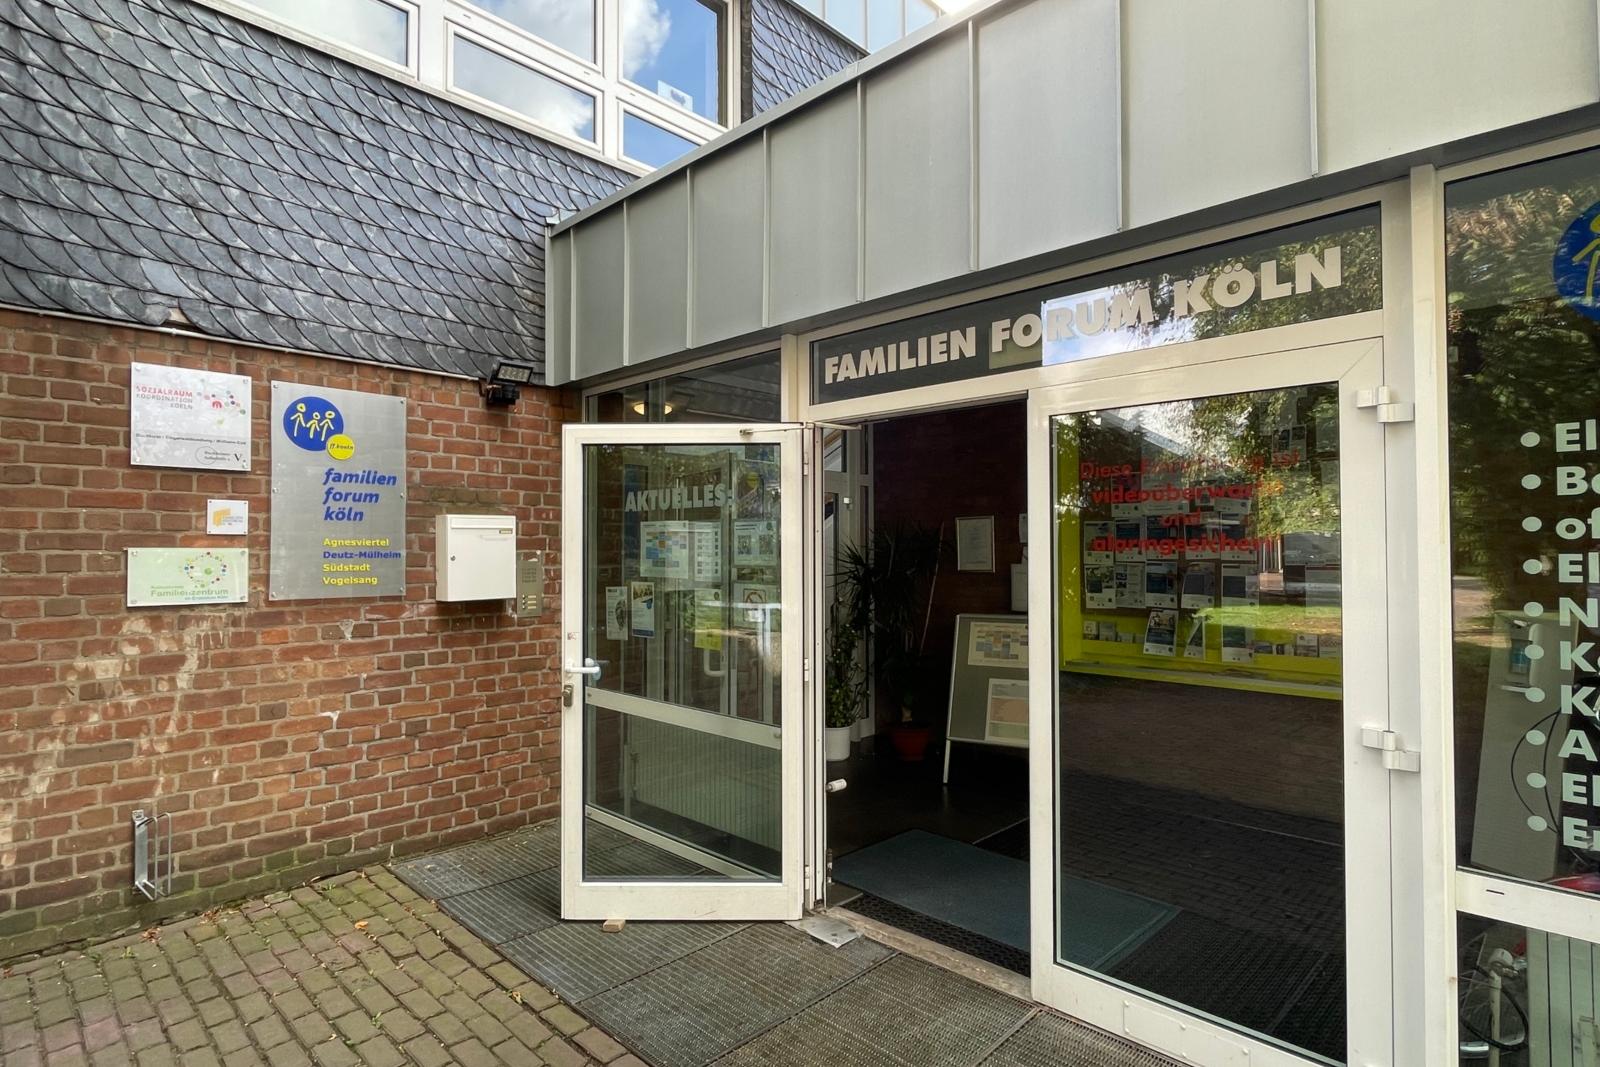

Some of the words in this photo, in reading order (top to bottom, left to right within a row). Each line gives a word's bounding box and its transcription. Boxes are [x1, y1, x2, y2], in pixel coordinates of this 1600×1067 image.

[824, 327, 976, 385] FAMILIEN
[991, 287, 1156, 353] FORUM
[1174, 246, 1343, 317] KÖLN
[322, 468, 398, 487] familien
[322, 487, 380, 505] forum
[323, 506, 364, 522] köln
[323, 538, 390, 549] Agnesviertel
[322, 550, 402, 560] Deutz-Mülheim
[322, 563, 371, 573] Südstadt
[322, 576, 378, 586] Vogelsang
